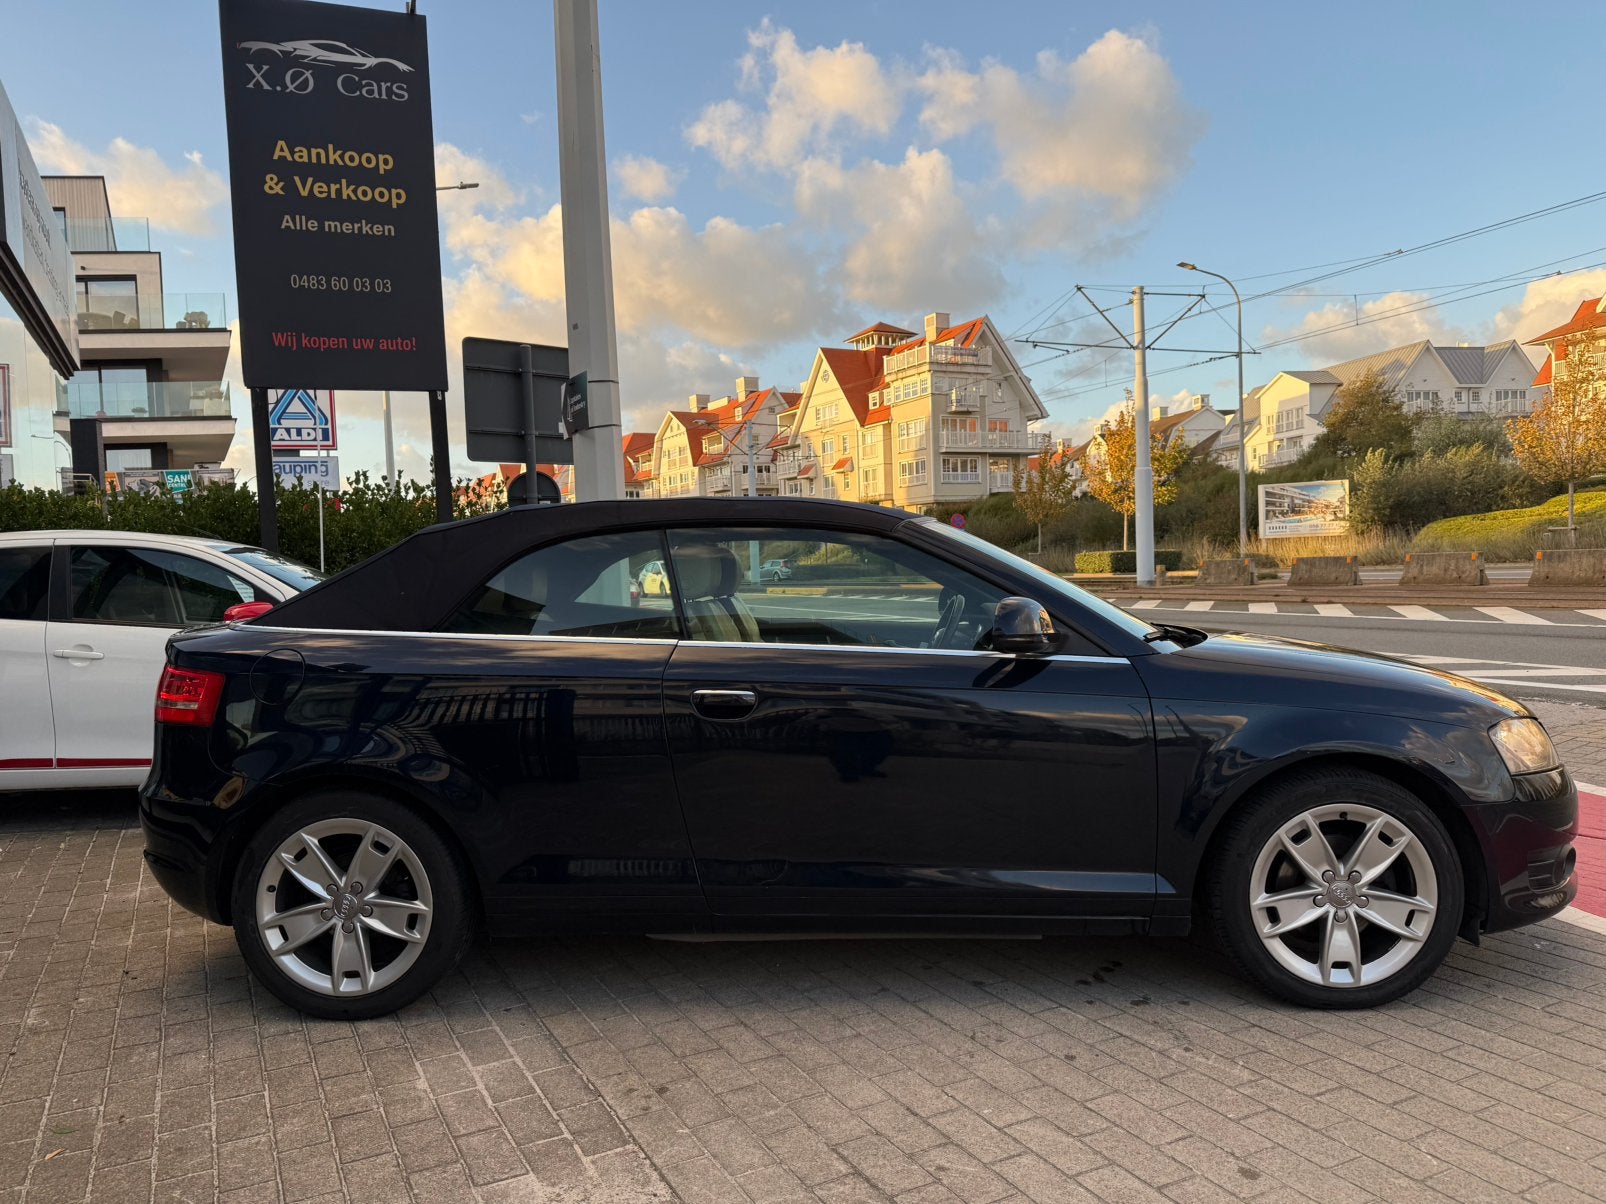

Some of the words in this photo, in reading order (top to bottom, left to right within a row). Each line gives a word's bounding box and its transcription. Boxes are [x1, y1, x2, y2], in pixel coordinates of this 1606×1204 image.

[336, 73, 409, 101] Cars
[272, 140, 394, 174] Aankoop
[263, 173, 286, 195] &
[293, 175, 407, 208] Verkoop
[280, 214, 319, 231] Alle
[324, 219, 395, 237] merken
[290, 274, 327, 290] 0483
[331, 276, 349, 291] 60
[353, 277, 371, 292] 03
[375, 279, 392, 293] 03
[272, 331, 297, 351] Wij
[301, 333, 348, 351] kopen
[352, 335, 375, 350] uw
[378, 337, 417, 351] auto!
[272, 428, 323, 441] ALDI
